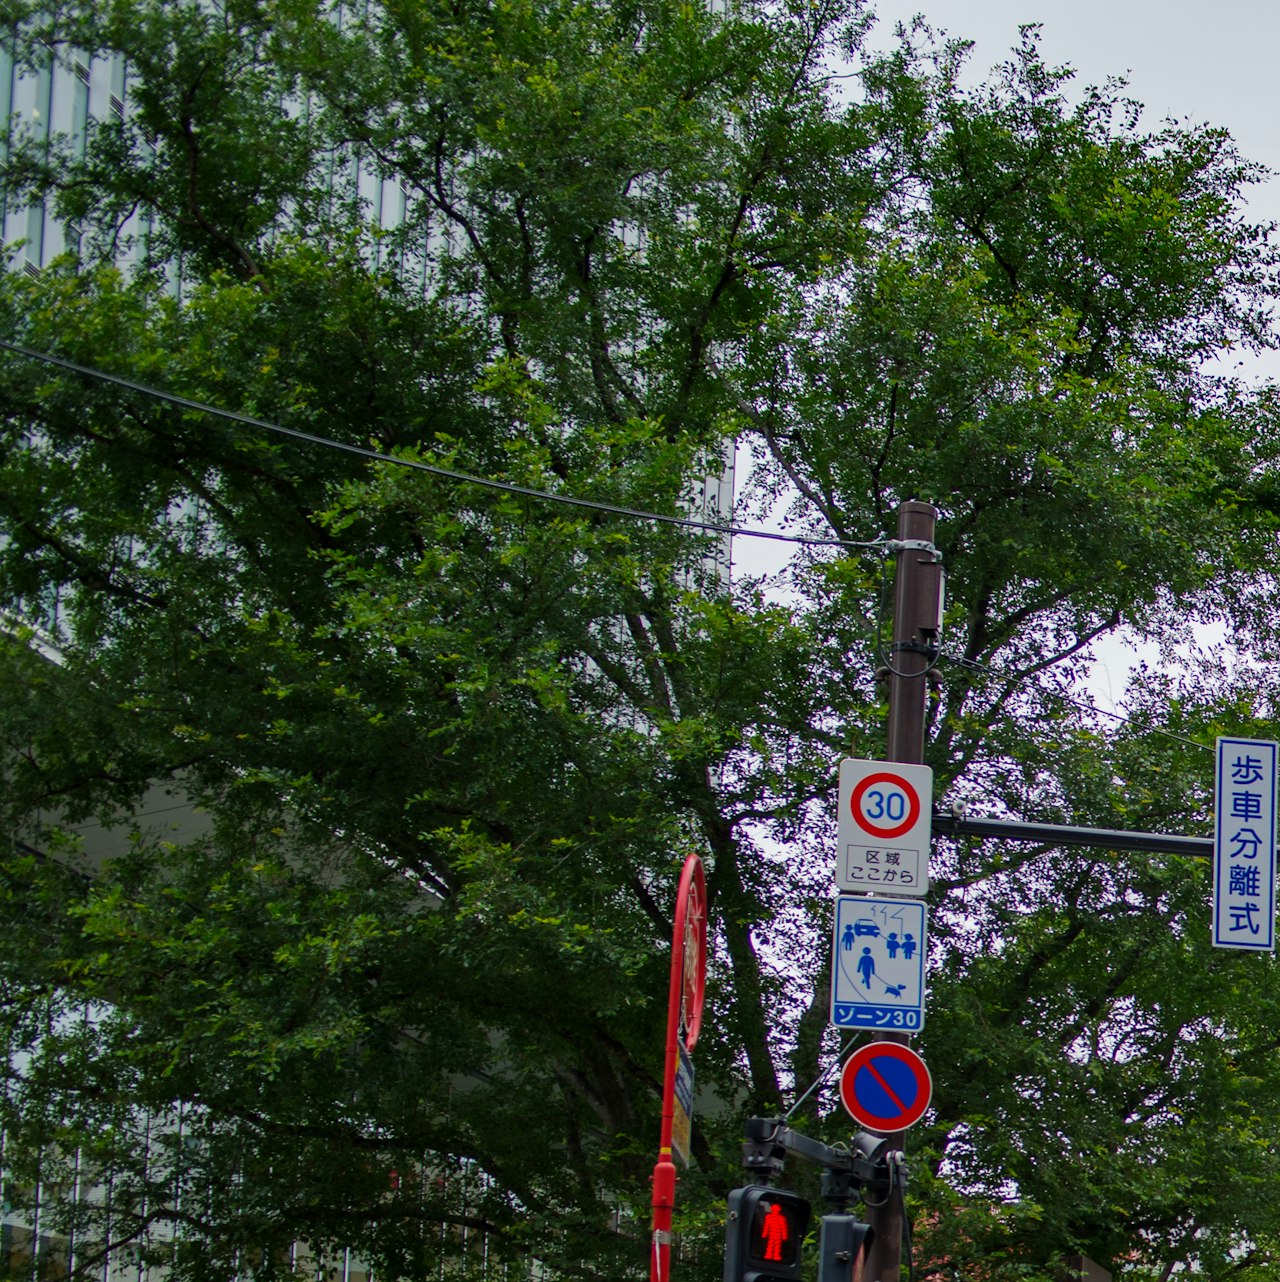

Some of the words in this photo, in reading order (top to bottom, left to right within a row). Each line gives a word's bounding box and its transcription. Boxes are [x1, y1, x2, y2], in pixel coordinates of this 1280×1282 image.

[866, 790, 905, 821] 30
[1229, 755, 1264, 935] 歩車分離式
[865, 850, 900, 866] 区域
[850, 866, 914, 883] ここから
[838, 1007, 917, 1027] ゾーン30
